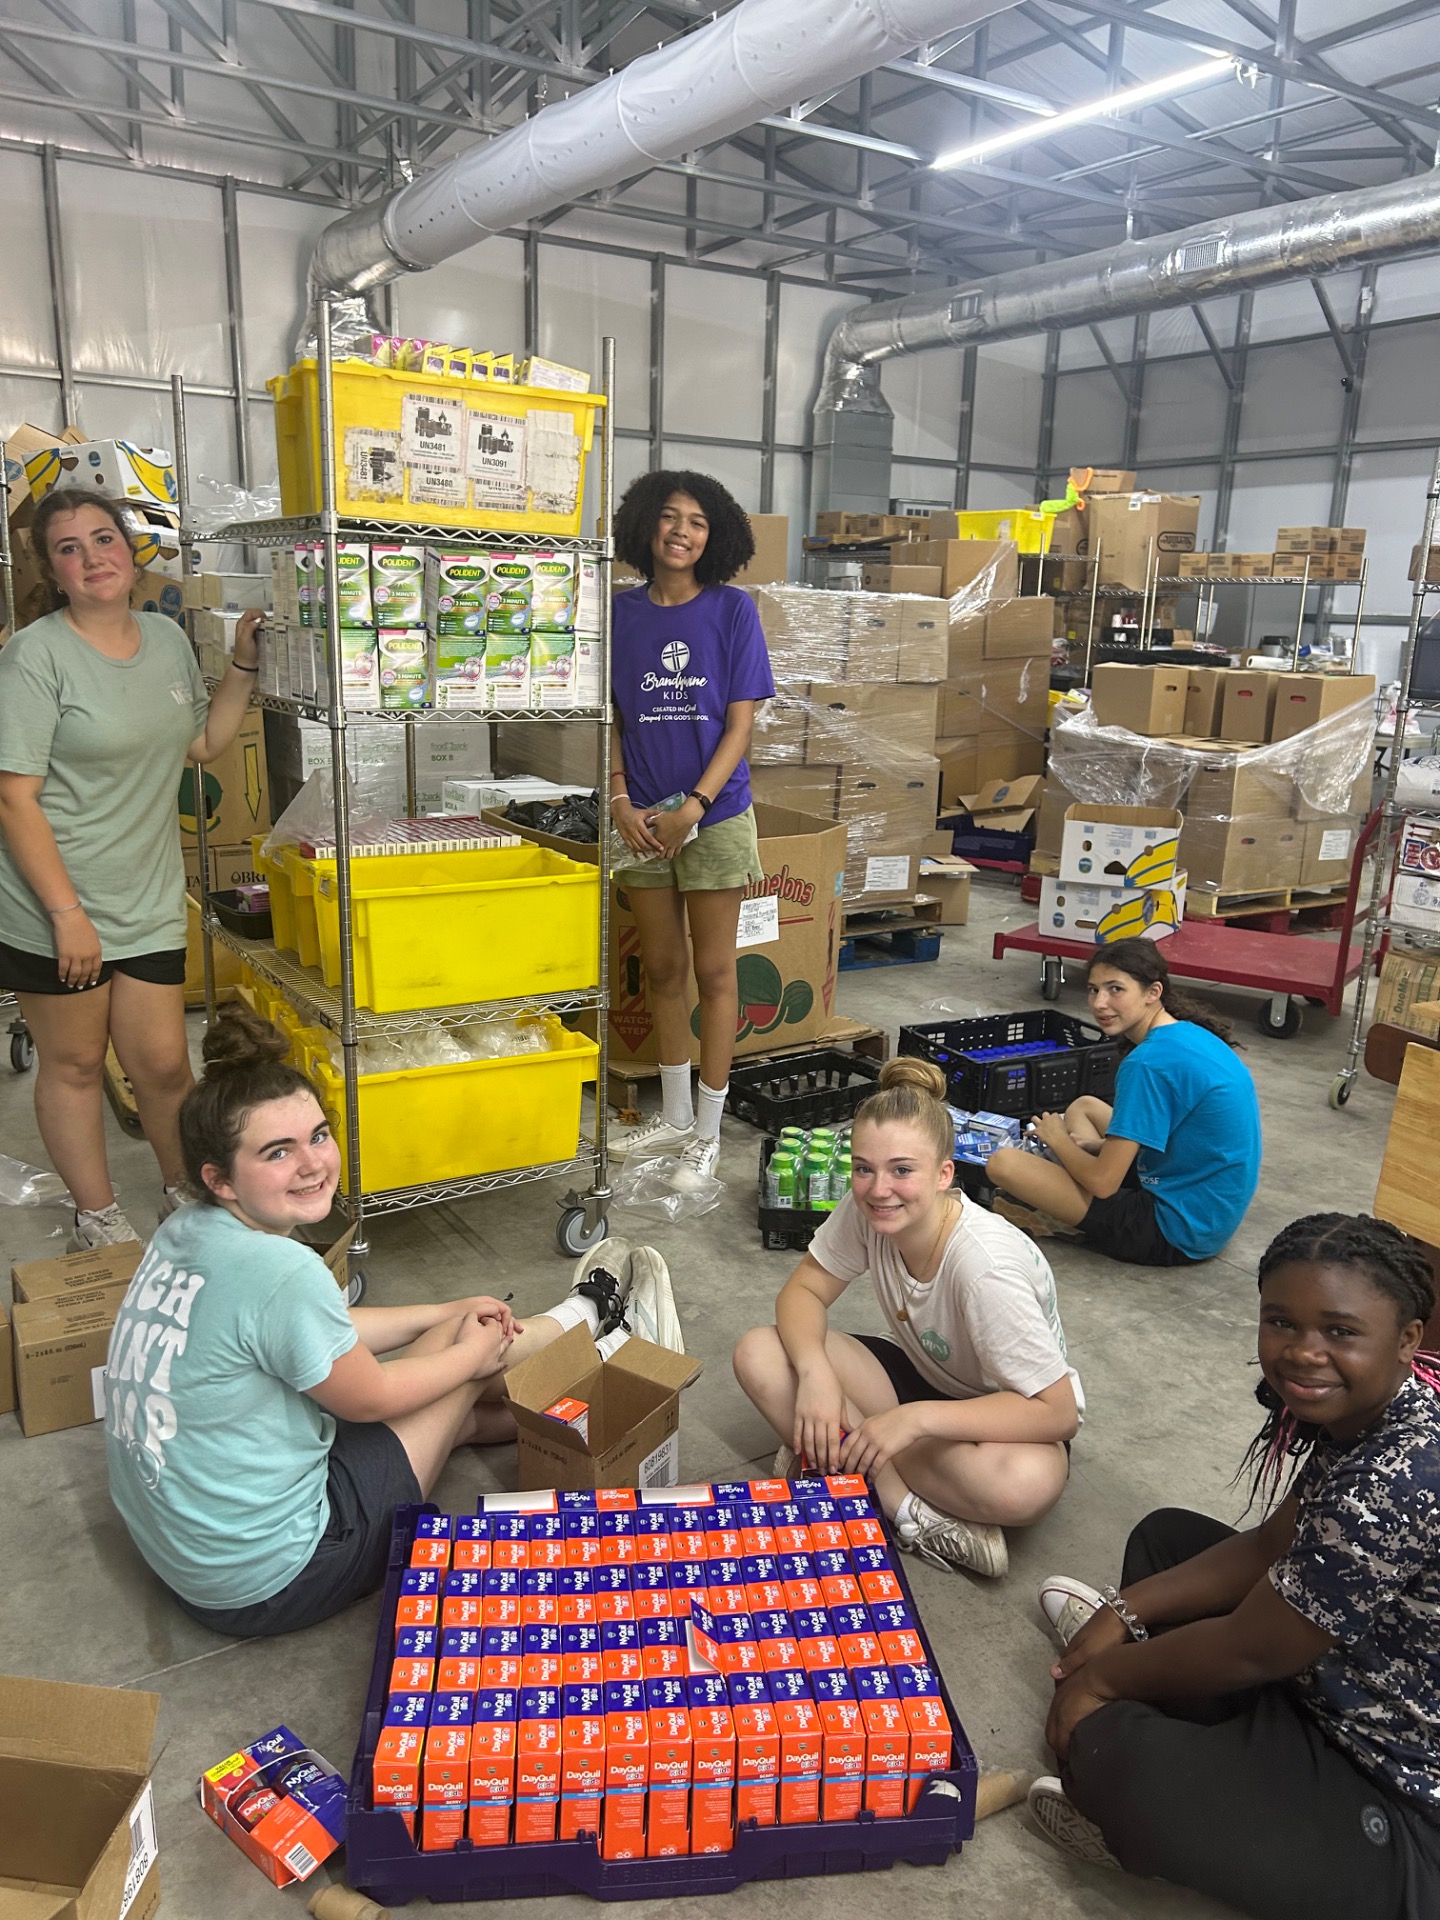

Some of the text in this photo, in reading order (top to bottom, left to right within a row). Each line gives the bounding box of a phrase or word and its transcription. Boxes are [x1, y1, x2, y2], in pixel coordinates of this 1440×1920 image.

[420, 441, 446, 451] UN3481
[482, 457, 507, 468] UN3091
[338, 557, 360, 565] IDENT
[537, 565, 566, 573] POLIDENT
[450, 569, 481, 577] POLIDENT
[388, 642, 421, 650] POLIDENT
[641, 672, 708, 691] Brandywine
[663, 691, 688, 699] KIDS
[402, 805, 421, 813] BX
[613, 1015, 653, 1024] WATCH
[620, 1027, 648, 1035] STEP
[124, 1242, 205, 1329] IGH
[109, 1312, 188, 1392] INT
[848, 1608, 862, 1629] NyQuil
[887, 1606, 901, 1626] NyQuil
[658, 1621, 670, 1641] NyQuil
[732, 1618, 745, 1638] NyQuil
[414, 1631, 425, 1652] NyQuil
[501, 1631, 512, 1651] NyQuil
[541, 1628, 552, 1649] NyQuil
[664, 1681, 676, 1703] NyQuil
[705, 1679, 718, 1701] NyQuil
[746, 1677, 760, 1698] NyQuil
[786, 1673, 800, 1695] NyQuil
[828, 1673, 842, 1695] NyQuil
[871, 1671, 886, 1694] NyQuil
[494, 1693, 506, 1716] NyQuil
[538, 1691, 549, 1714] NyQuil
[581, 1688, 593, 1710] NyQuil
[623, 1685, 634, 1706] NyQuil
[403, 1697, 417, 1721] NyQuil
[449, 1696, 461, 1720] NyQuil
[794, 1705, 808, 1728] DayQuil
[838, 1705, 851, 1728] DayQuil
[880, 1704, 895, 1728] DayQuil
[922, 1702, 937, 1727] DayQuil
[625, 1716, 636, 1740] DayQuil
[667, 1713, 678, 1735] DayQuil
[710, 1711, 721, 1734] DayQuil
[753, 1708, 766, 1731] DayQuil
[492, 1727, 503, 1752] DayQuil
[539, 1724, 549, 1748] DayQuil
[583, 1721, 593, 1745] DayQuil
[258, 1734, 284, 1754] NyQuil
[396, 1732, 410, 1758] DayQuil
[446, 1731, 458, 1756] DayQuil
[698, 1759, 732, 1769] DayQuil
[743, 1756, 776, 1766] DayQuil
[786, 1752, 819, 1763] DayQuil
[801, 1760, 818, 1768] Kids
[829, 1755, 862, 1765] DayQuil
[872, 1753, 905, 1763] DayQuil
[887, 1760, 904, 1768] Kids
[915, 1750, 948, 1761] DayQuil
[929, 1758, 946, 1767] Kids
[566, 1770, 601, 1780] DayQuil
[611, 1765, 645, 1774] DayQuil
[655, 1761, 688, 1771] DayQuil
[713, 1767, 730, 1775] Kids
[844, 1762, 861, 1770] Kids
[285, 1765, 319, 1788] NyQuil
[474, 1778, 509, 1787] DayQuil
[522, 1774, 556, 1784] DayQuil
[626, 1773, 644, 1781] Kids
[378, 1784, 413, 1794] DayQuil
[394, 1791, 412, 1799] Kids
[428, 1782, 463, 1793] DayQuil
[444, 1790, 463, 1798] Kids
[243, 1791, 277, 1816] DayQuil
